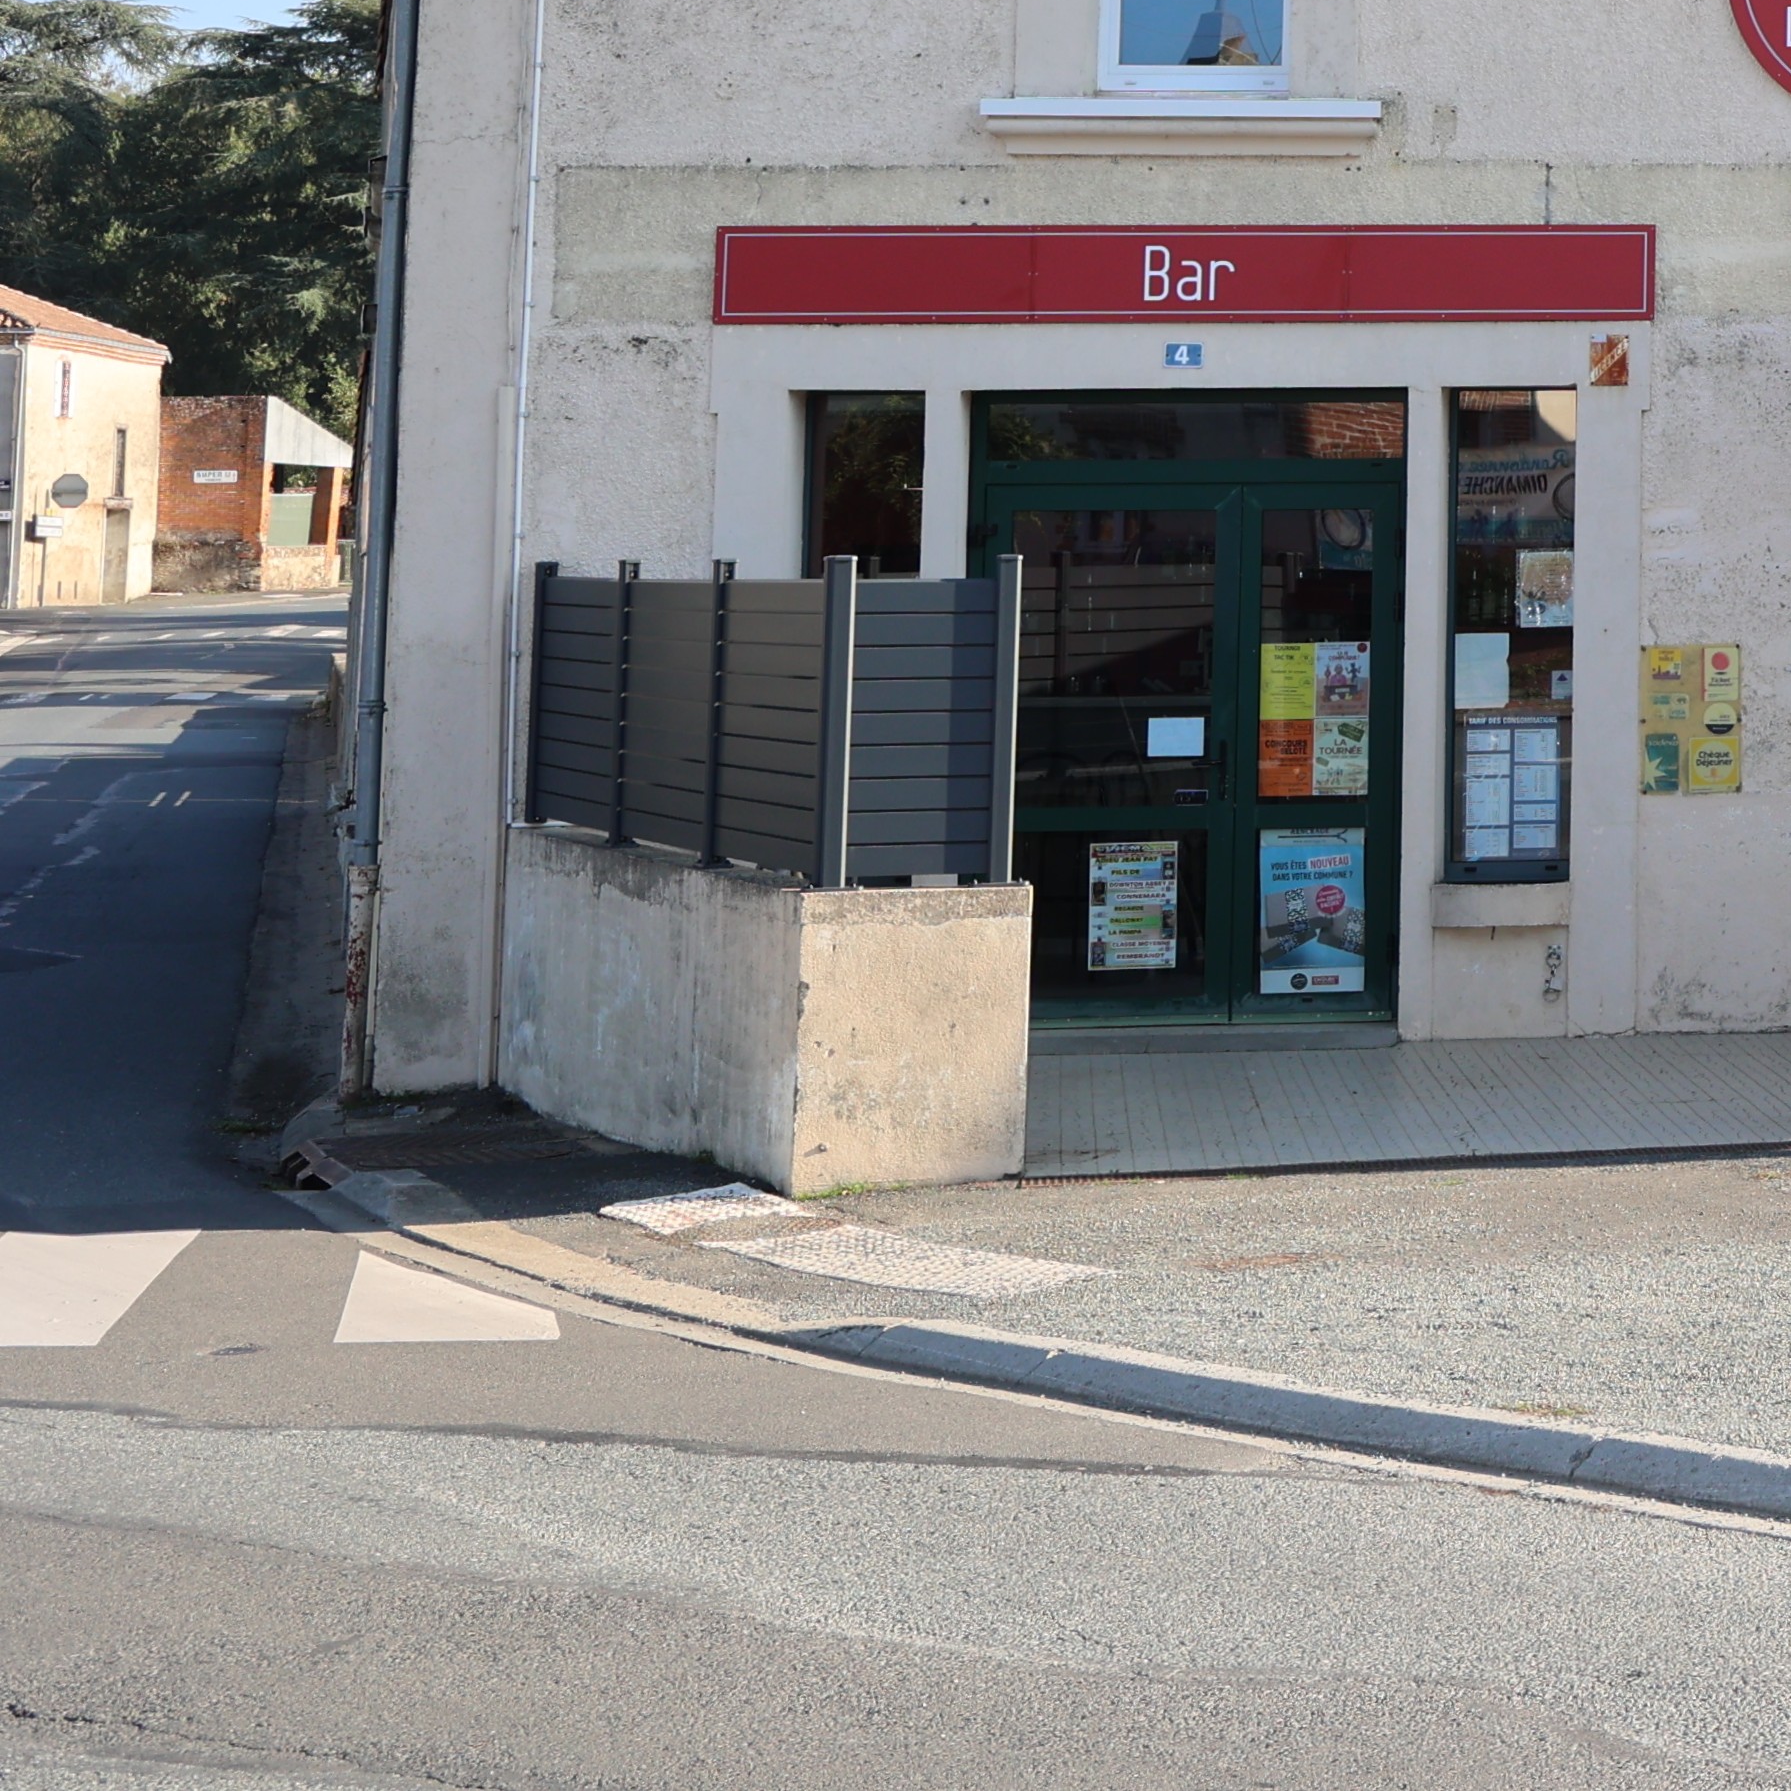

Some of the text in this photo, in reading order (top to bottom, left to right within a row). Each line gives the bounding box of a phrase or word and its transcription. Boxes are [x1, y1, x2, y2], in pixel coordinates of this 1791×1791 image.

[1143, 245, 1236, 302] Bar
[1173, 345, 1190, 365] 4
[1334, 738, 1347, 746] LA
[1309, 855, 1349, 870] NOUVEAU
